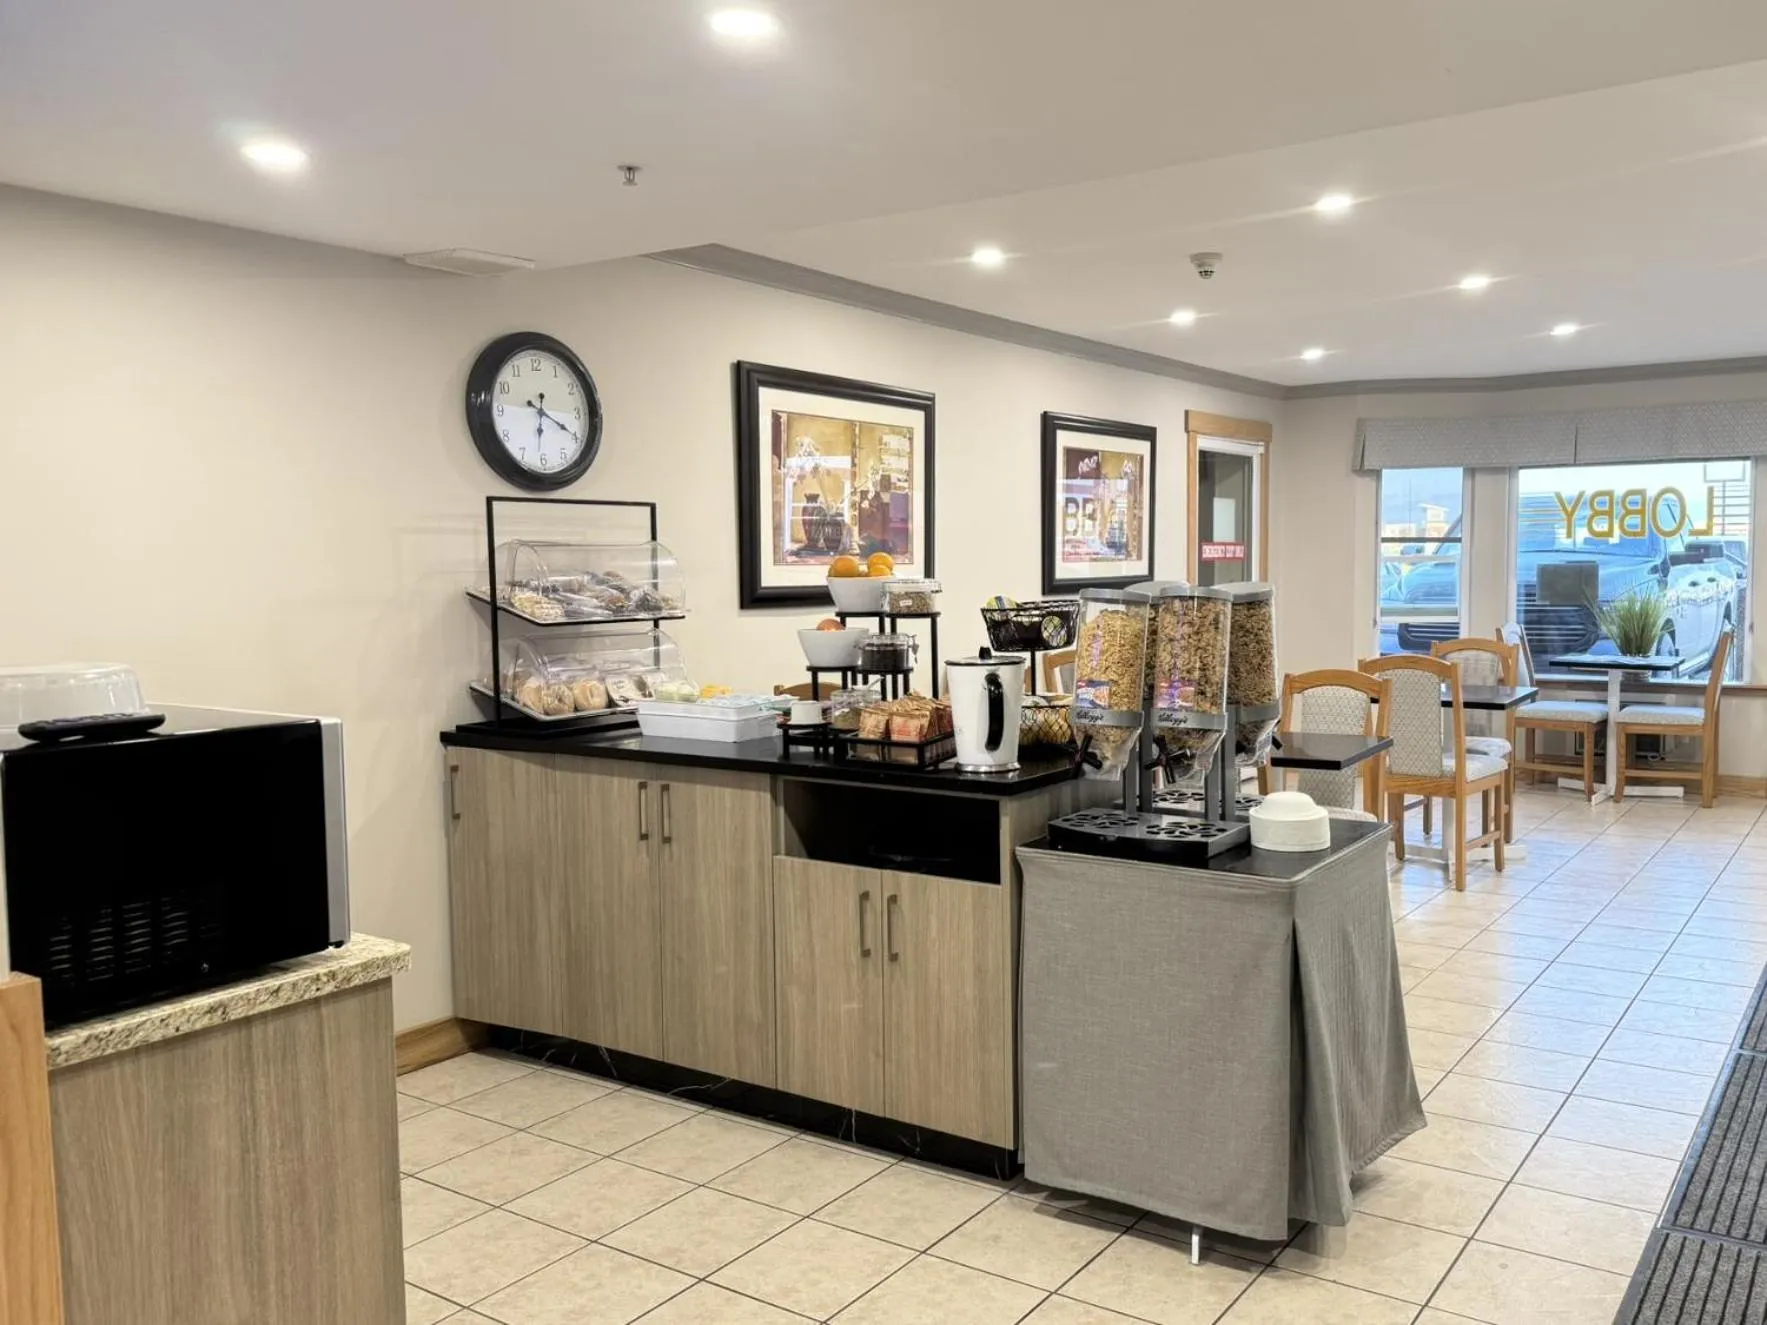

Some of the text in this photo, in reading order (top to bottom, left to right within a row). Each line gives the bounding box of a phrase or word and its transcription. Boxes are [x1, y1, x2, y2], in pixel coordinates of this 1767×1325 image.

[511, 364, 521, 378] 11
[530, 358, 542, 372] 12
[553, 366, 558, 378] 1
[499, 381, 510, 395] 10
[567, 383, 575, 395] 2
[496, 404, 504, 417] 9
[574, 407, 581, 420] 3
[502, 429, 510, 442] 8
[571, 431, 579, 444] 4
[519, 447, 526, 460] 7
[540, 453, 548, 466] 6
[560, 448, 568, 460] 5
[1158, 713, 1188, 725] Kellogg's
